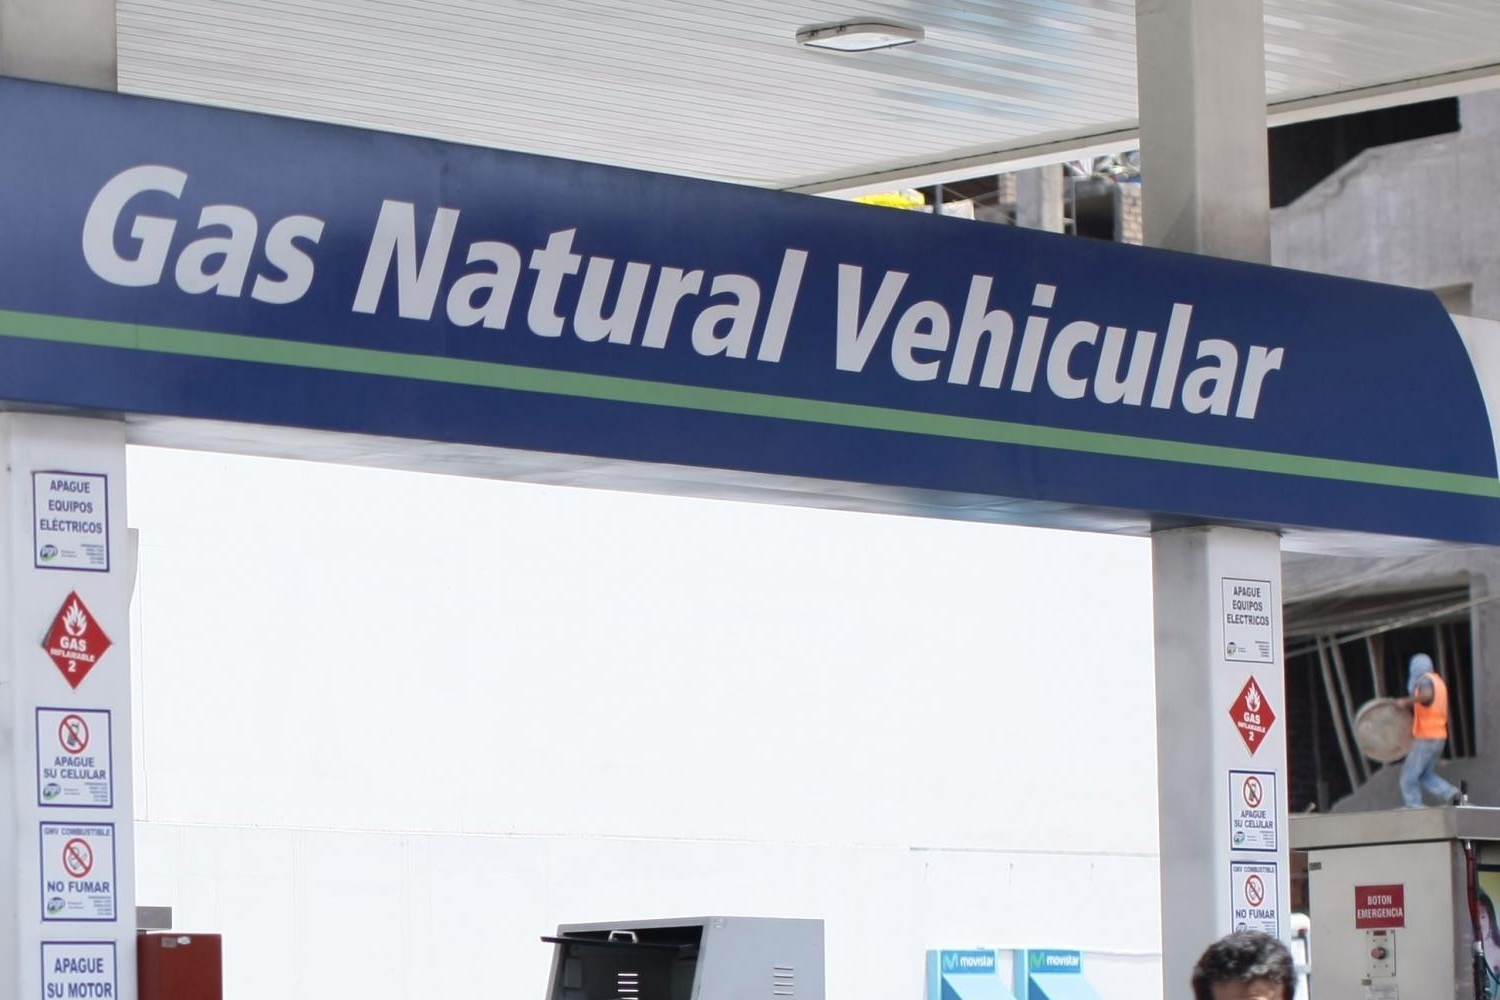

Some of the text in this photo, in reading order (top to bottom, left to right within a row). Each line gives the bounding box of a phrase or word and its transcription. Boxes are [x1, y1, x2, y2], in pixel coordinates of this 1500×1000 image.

[83, 166, 1284, 419] Gas Natural Vehicular
[50, 480, 91, 494] APAGUE
[48, 499, 94, 514] EQUIPOS
[1233, 586, 1260, 598] APAGUE
[1232, 600, 1263, 612] EQUIPOS
[59, 636, 87, 651] GAS
[68, 660, 76, 672] 2
[1243, 712, 1260, 724] GAS
[1248, 731, 1255, 741] 2
[54, 756, 95, 767] APAGUE
[43, 768, 106, 780] SU CELULAR
[1240, 810, 1266, 819] APAGUE
[1234, 819, 1273, 829] SU CELULAR
[47, 881, 110, 893] NO FUMAR
[1367, 895, 1392, 905] BOTON
[1235, 909, 1275, 919] NO FUMAR
[1357, 909, 1403, 919] EMERGENCIA
[54, 958, 104, 974] APAGUE
[959, 955, 994, 968] movistar
[1046, 955, 1079, 967] movistar
[47, 982, 112, 998] SU MOTOR
